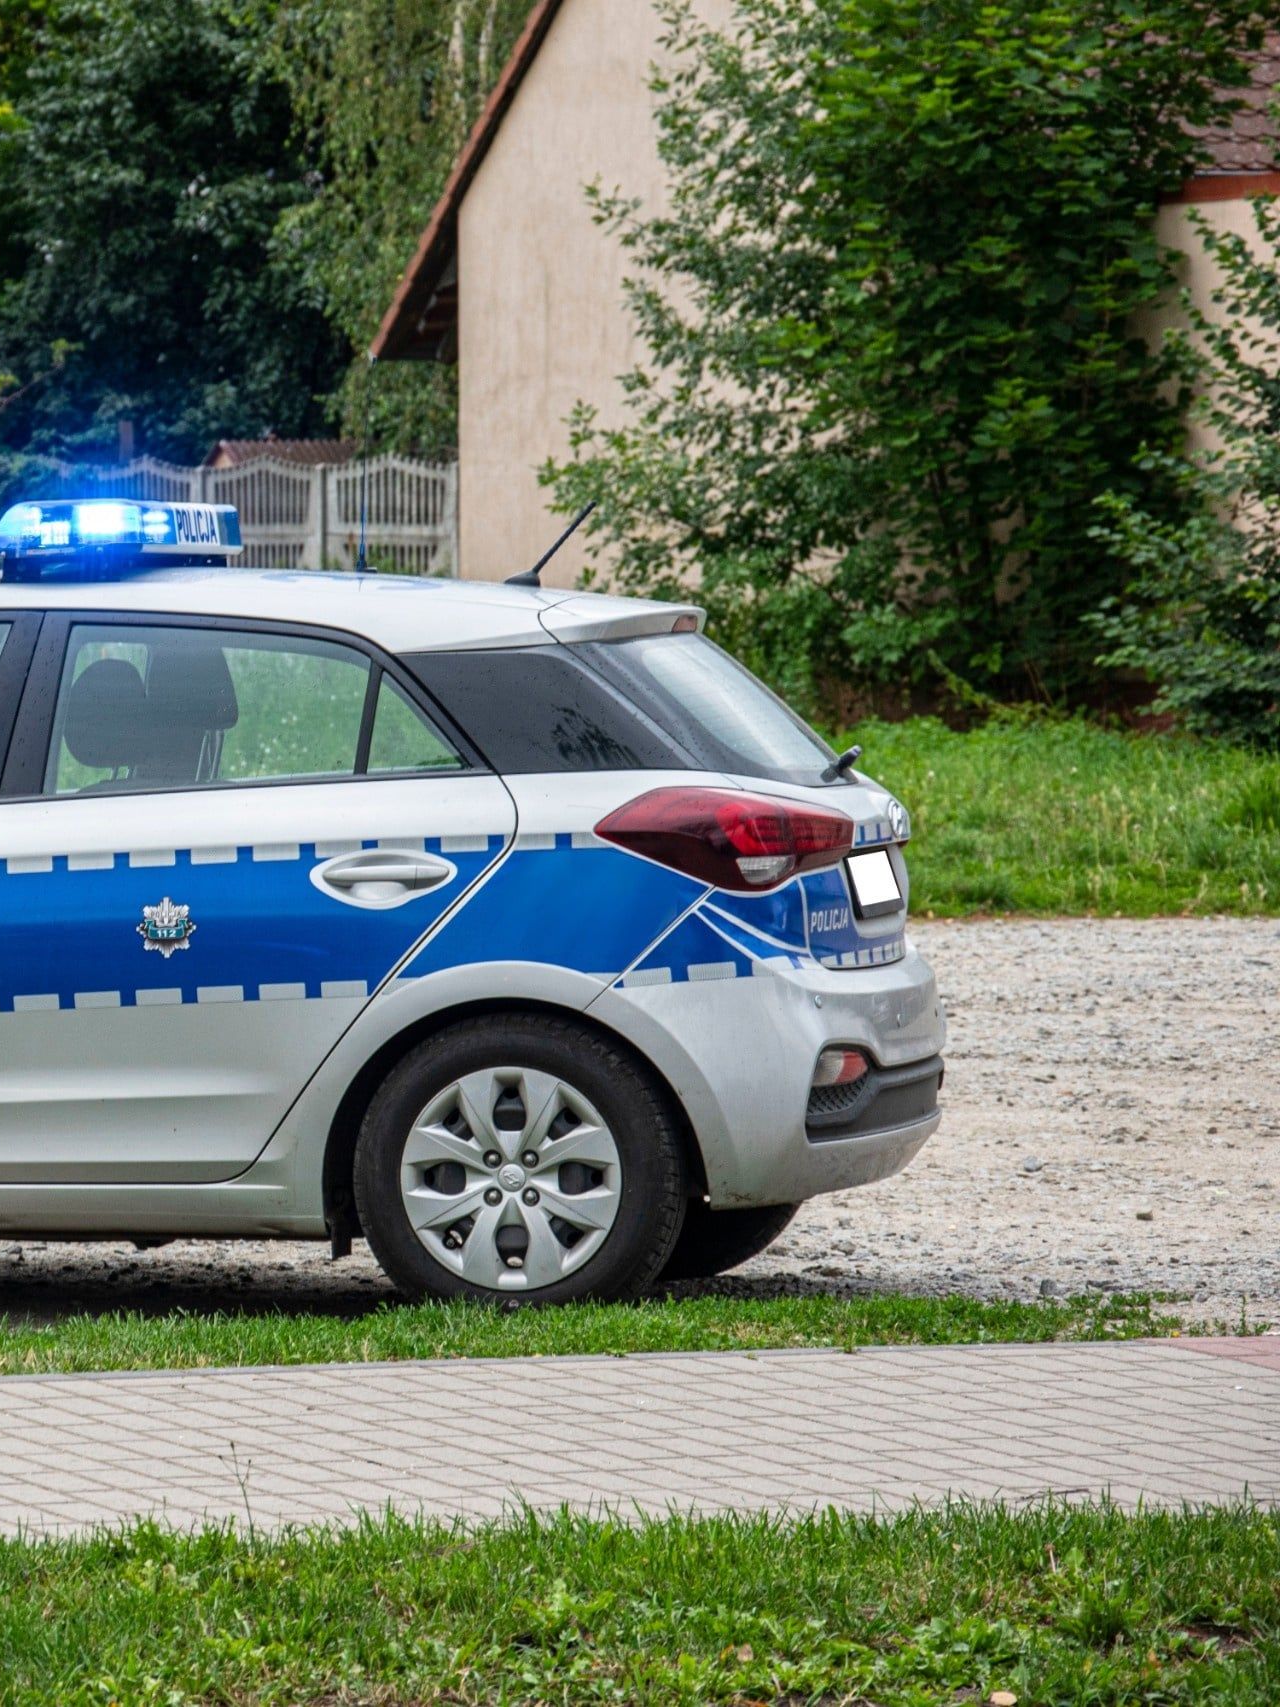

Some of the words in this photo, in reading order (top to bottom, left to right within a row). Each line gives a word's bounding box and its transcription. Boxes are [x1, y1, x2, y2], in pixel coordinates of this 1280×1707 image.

[175, 508, 218, 543] POLICJA
[810, 908, 849, 933] POLICJA
[156, 929, 176, 938] 112
